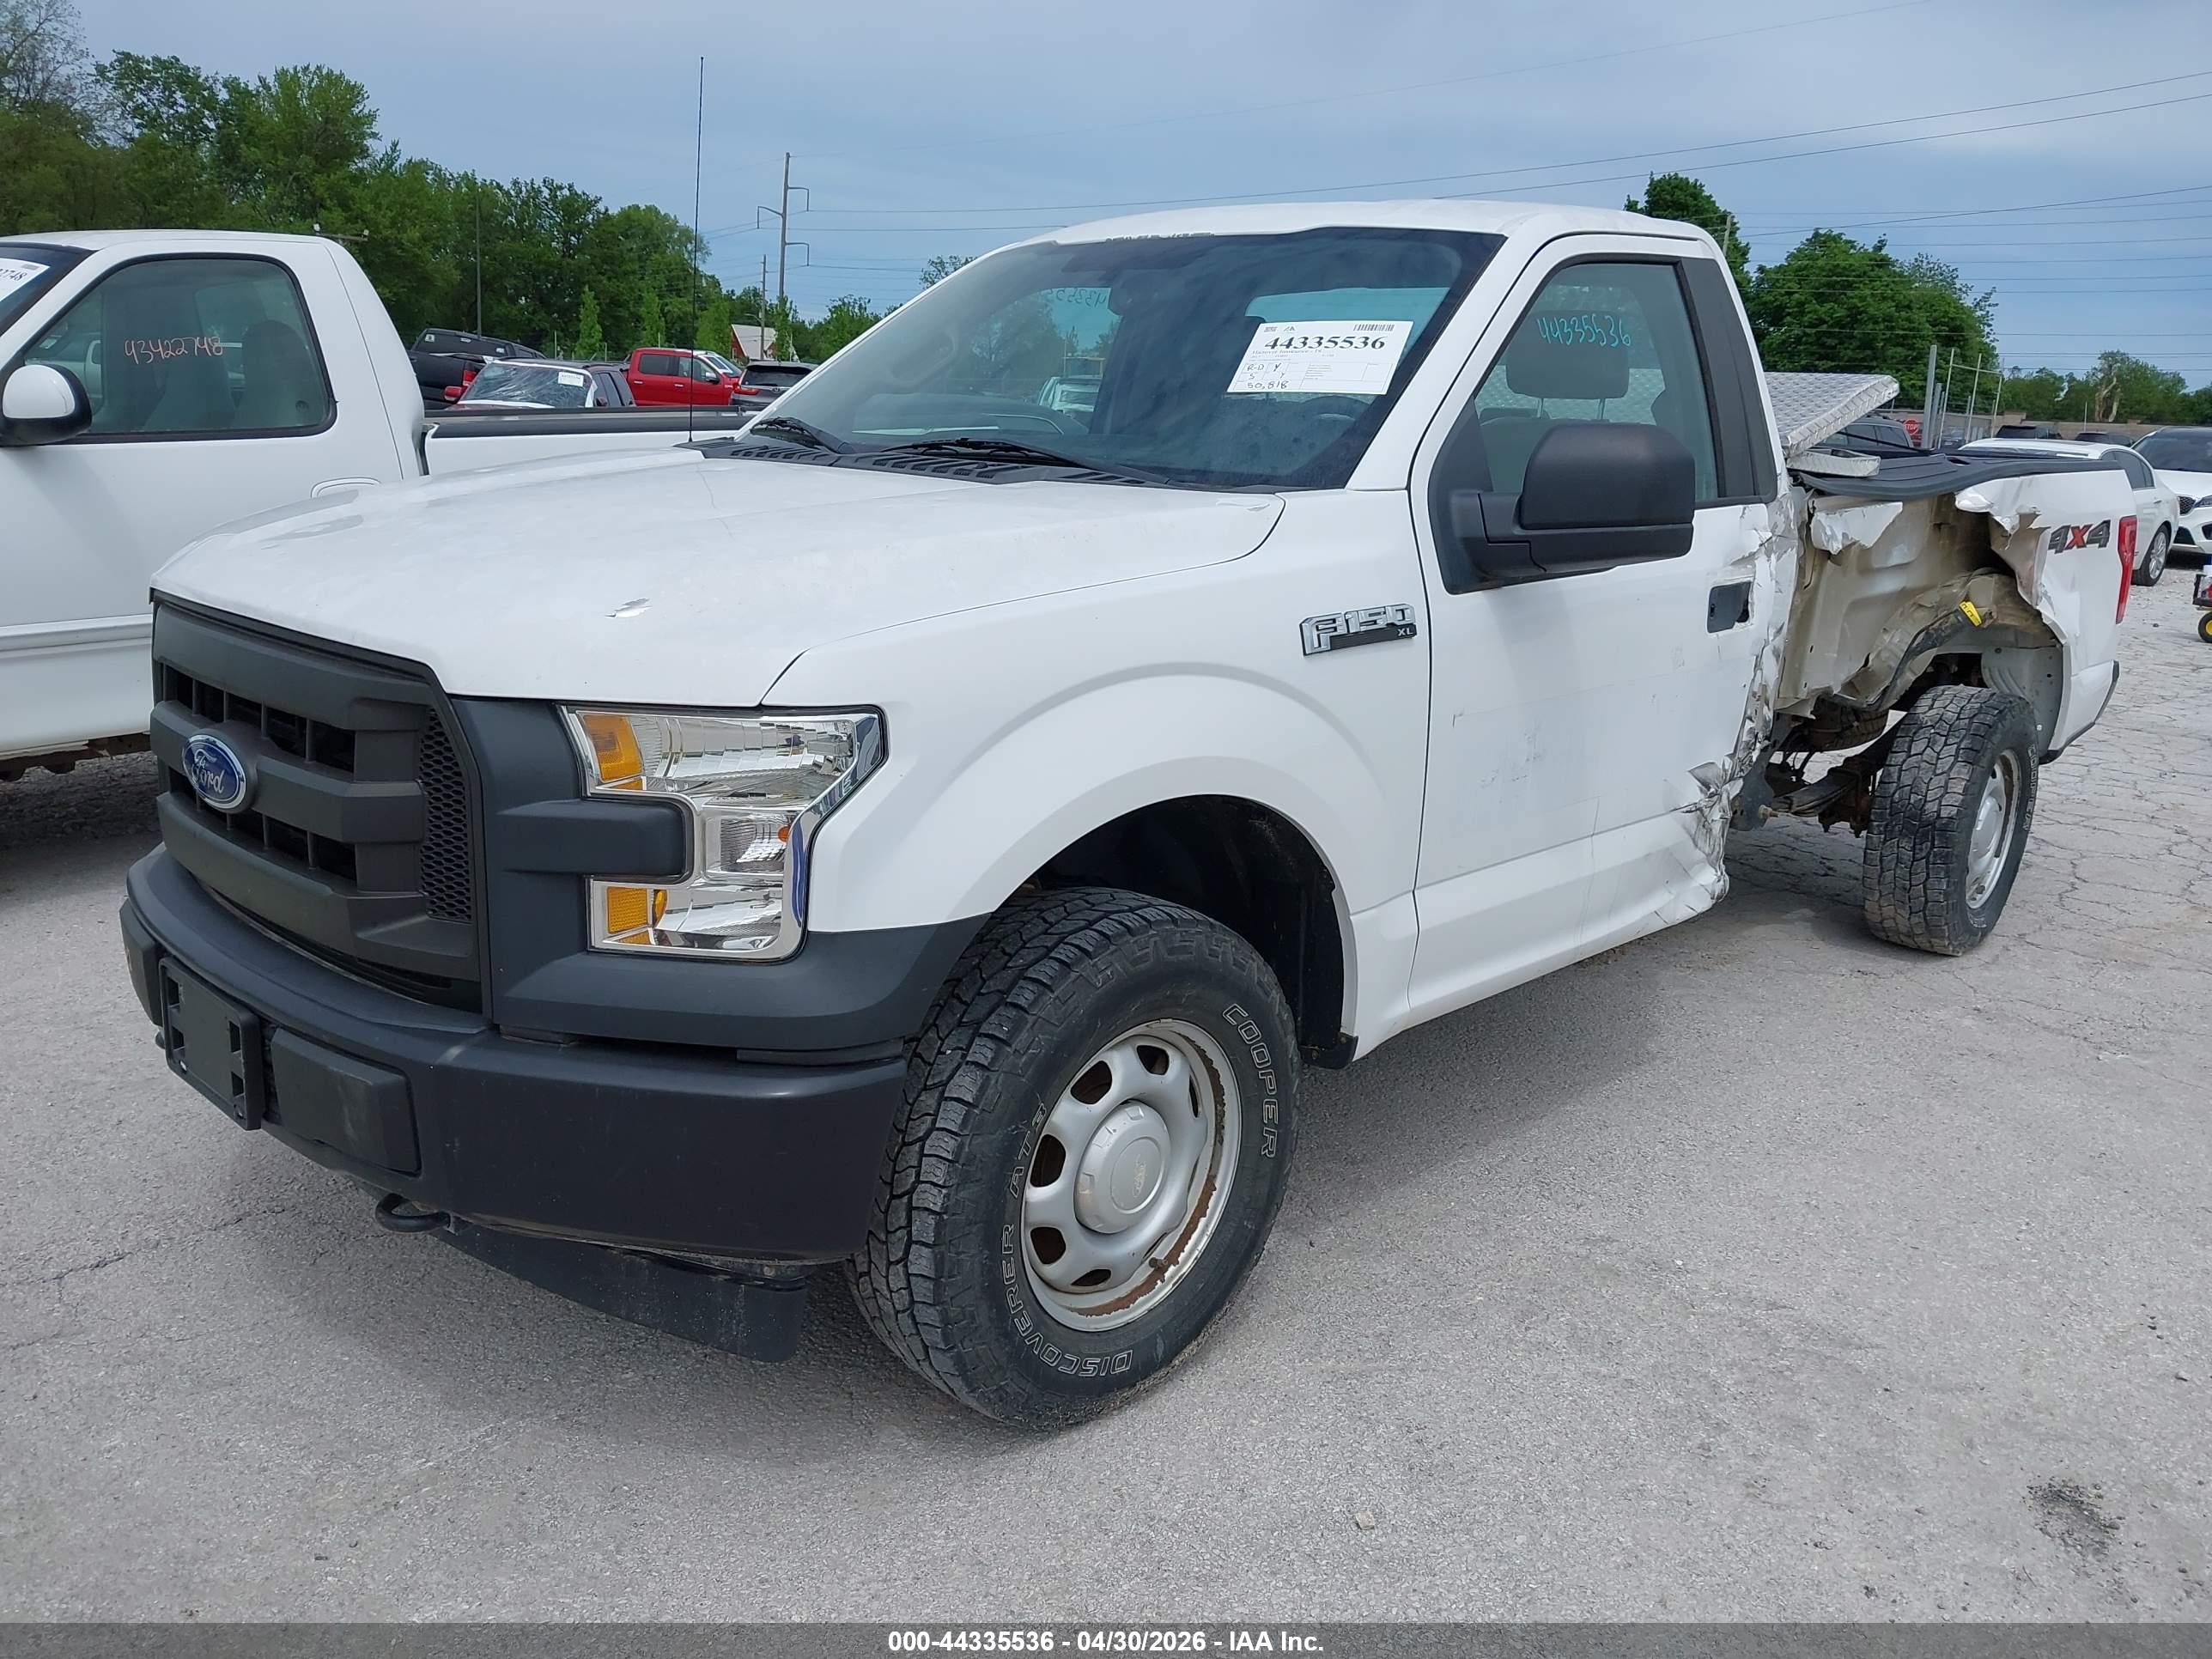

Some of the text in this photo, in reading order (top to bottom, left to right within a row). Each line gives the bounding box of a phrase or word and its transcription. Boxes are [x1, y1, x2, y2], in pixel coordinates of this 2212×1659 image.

[1264, 336, 1388, 349] 44335536
[1536, 313, 1632, 347] 44335536
[1299, 603, 1416, 656] F150
[1397, 628, 1414, 637] XL
[1221, 1002, 1279, 1159] COOPER
[1001, 1223, 1134, 1377] DISCOVERER
